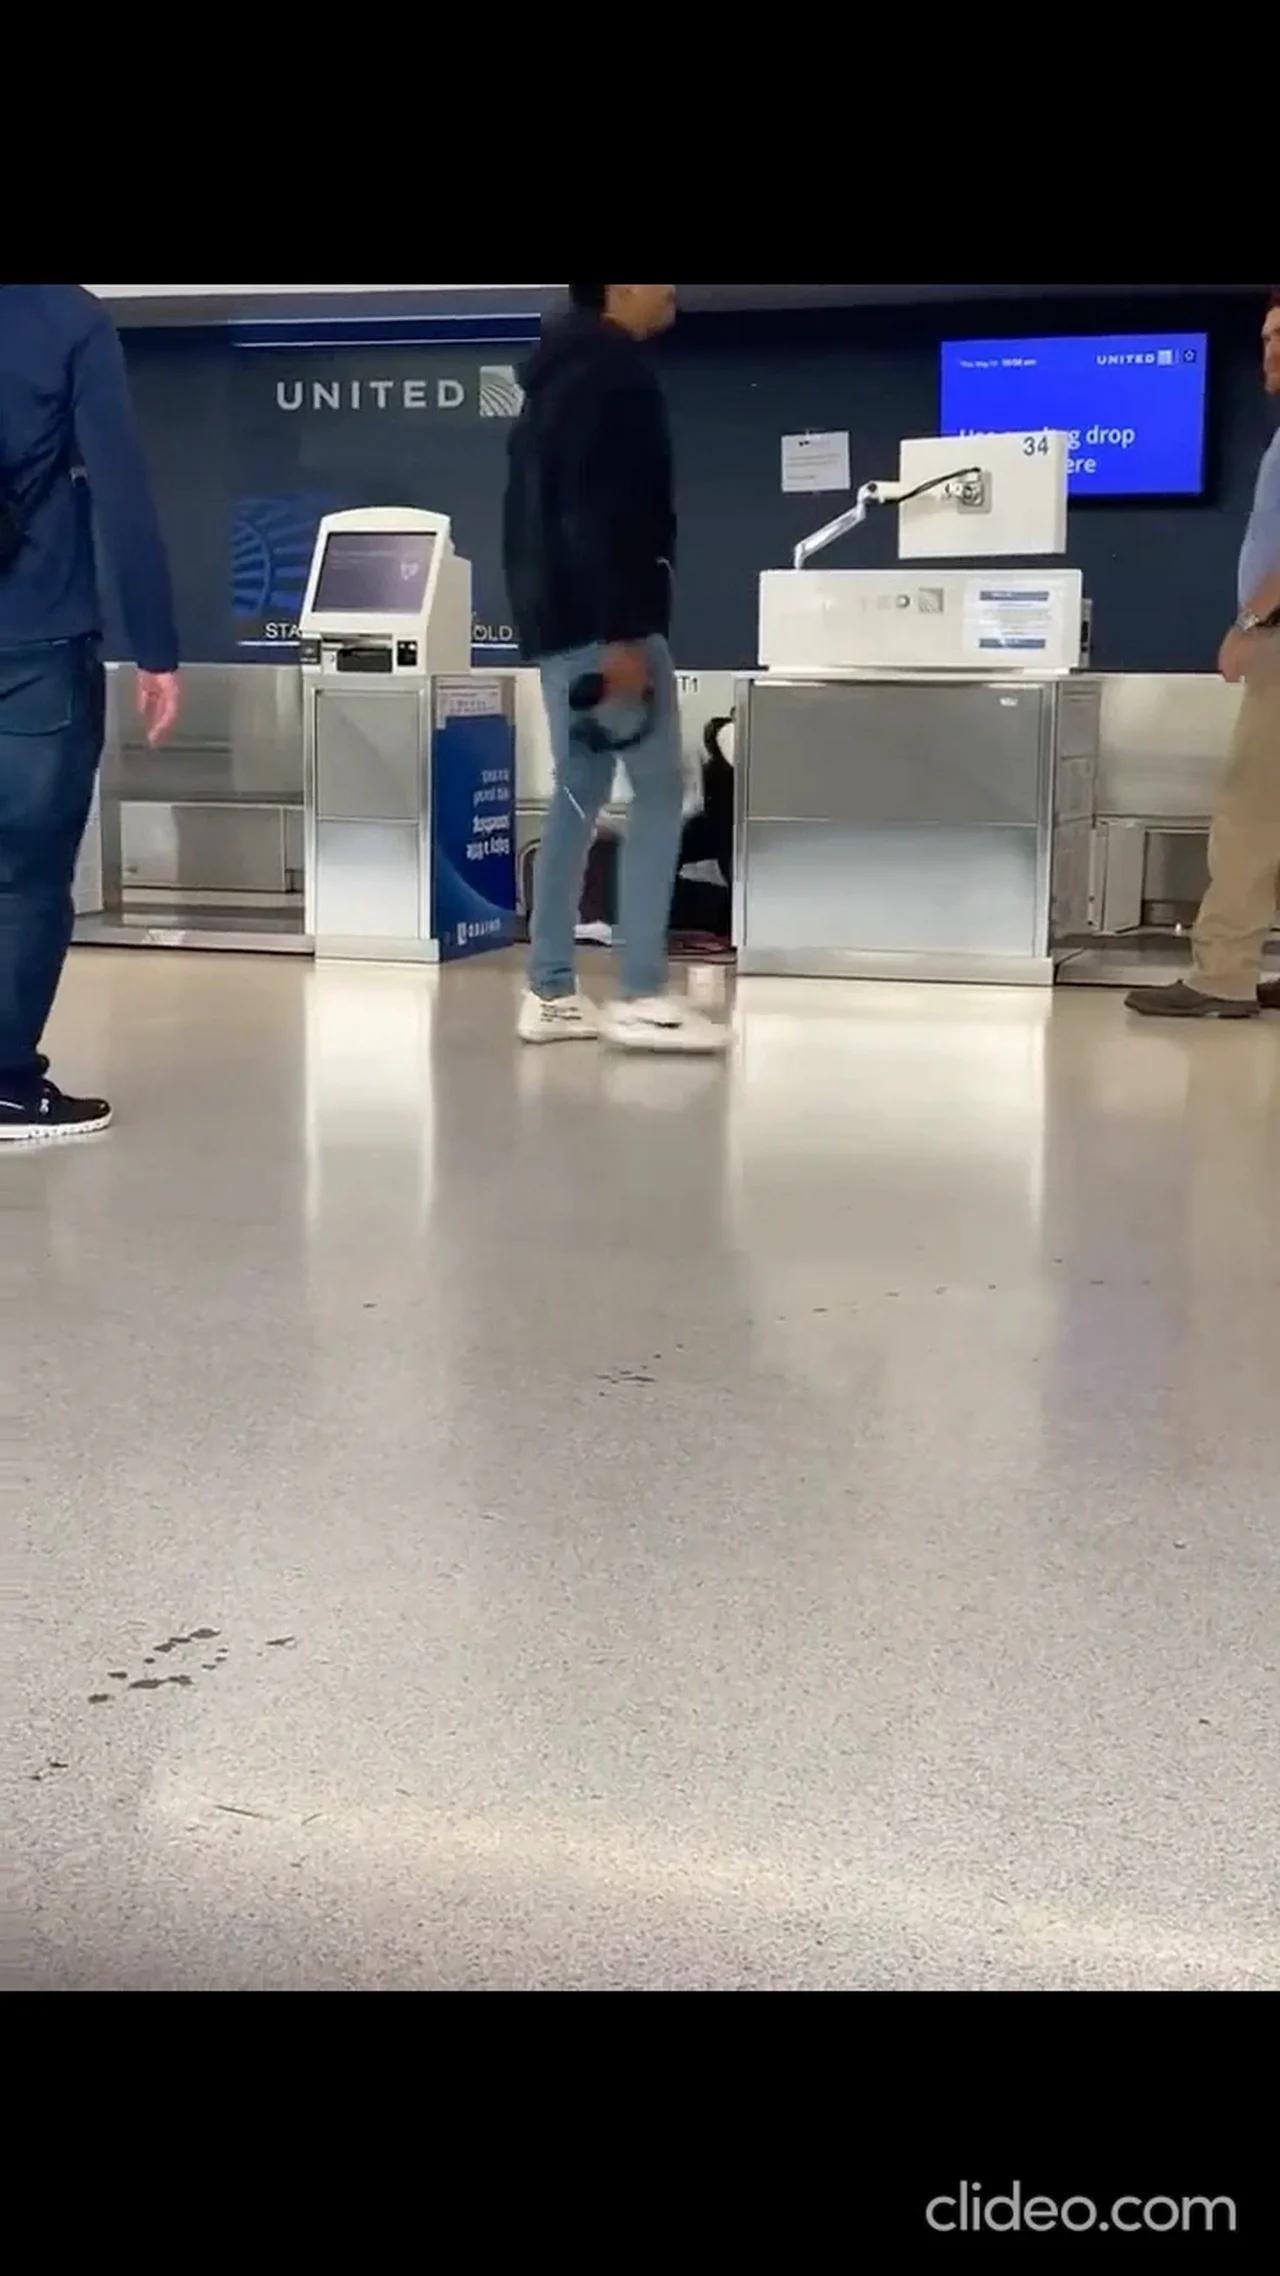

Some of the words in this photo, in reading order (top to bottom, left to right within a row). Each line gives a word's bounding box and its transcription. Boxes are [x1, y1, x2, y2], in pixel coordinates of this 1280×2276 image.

[1096, 353, 1155, 366] UNITED
[276, 379, 465, 410] UNITED
[1085, 424, 1136, 449] drop
[1023, 436, 1049, 456] 34
[1066, 457, 1097, 473] ere
[265, 622, 303, 639] STA
[472, 624, 513, 641] OLD
